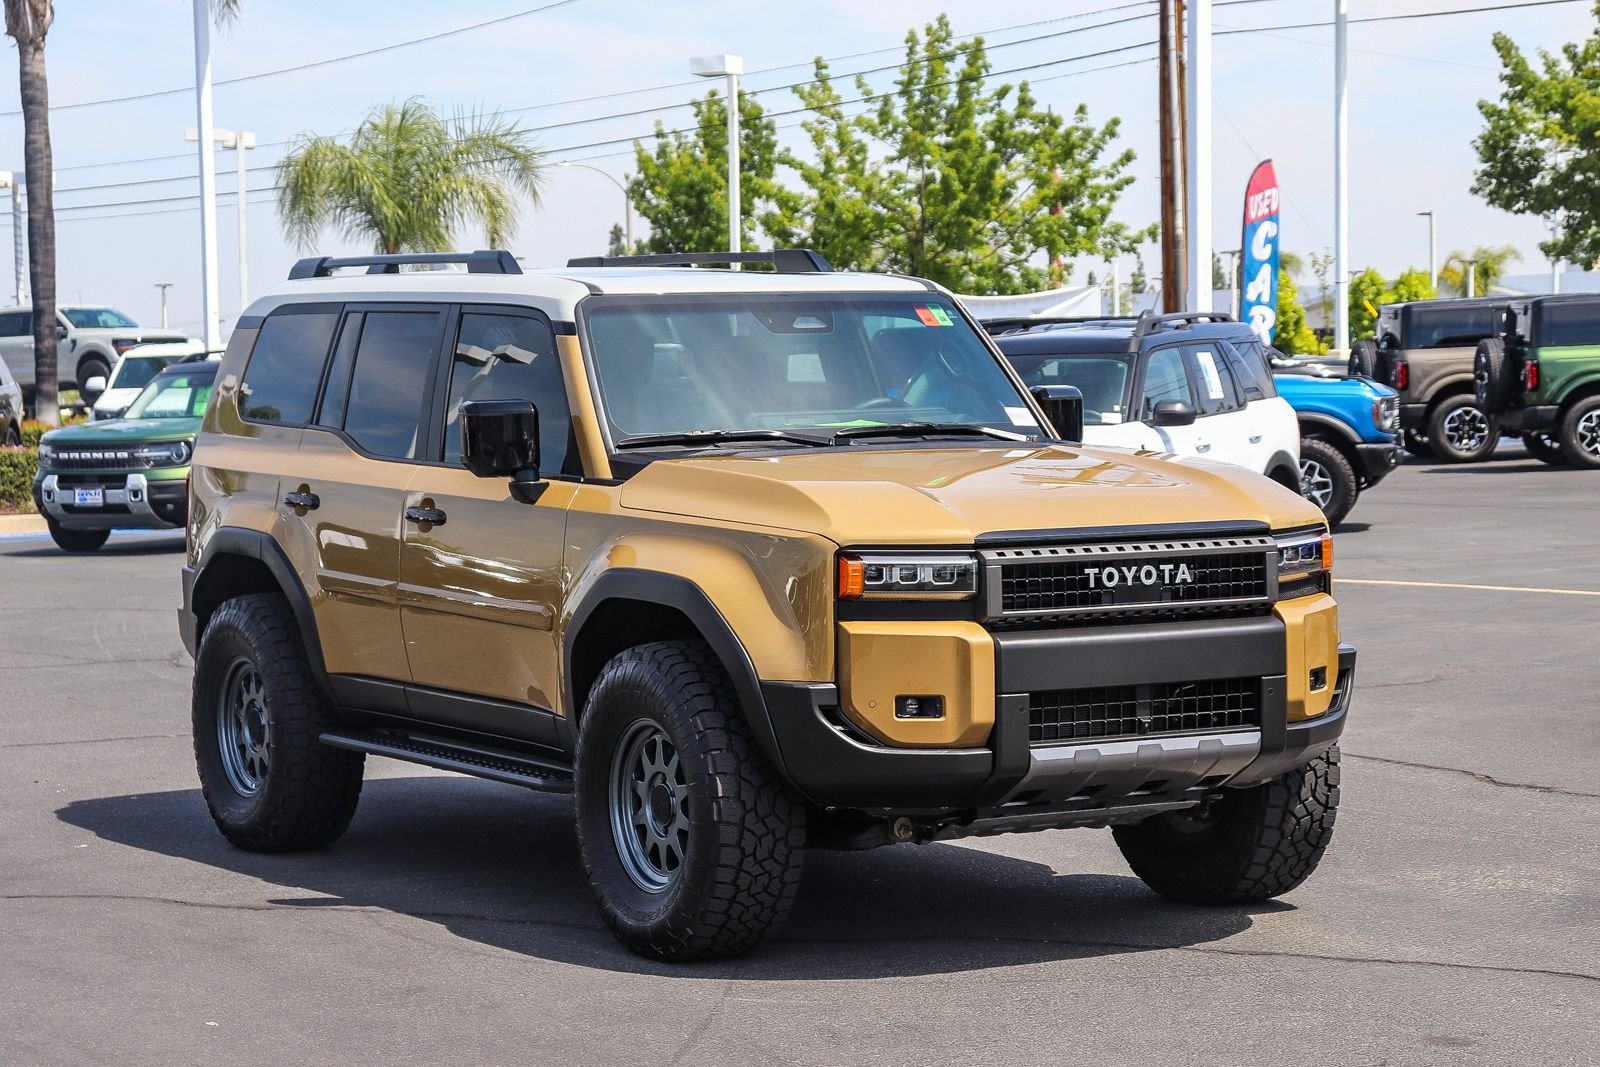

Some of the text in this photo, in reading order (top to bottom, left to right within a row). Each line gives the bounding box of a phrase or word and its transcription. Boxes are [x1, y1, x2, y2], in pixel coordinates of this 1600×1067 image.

[1248, 187, 1279, 219] USED
[59, 452, 129, 460] BRONCO
[1084, 563, 1192, 588] TOYOTA
